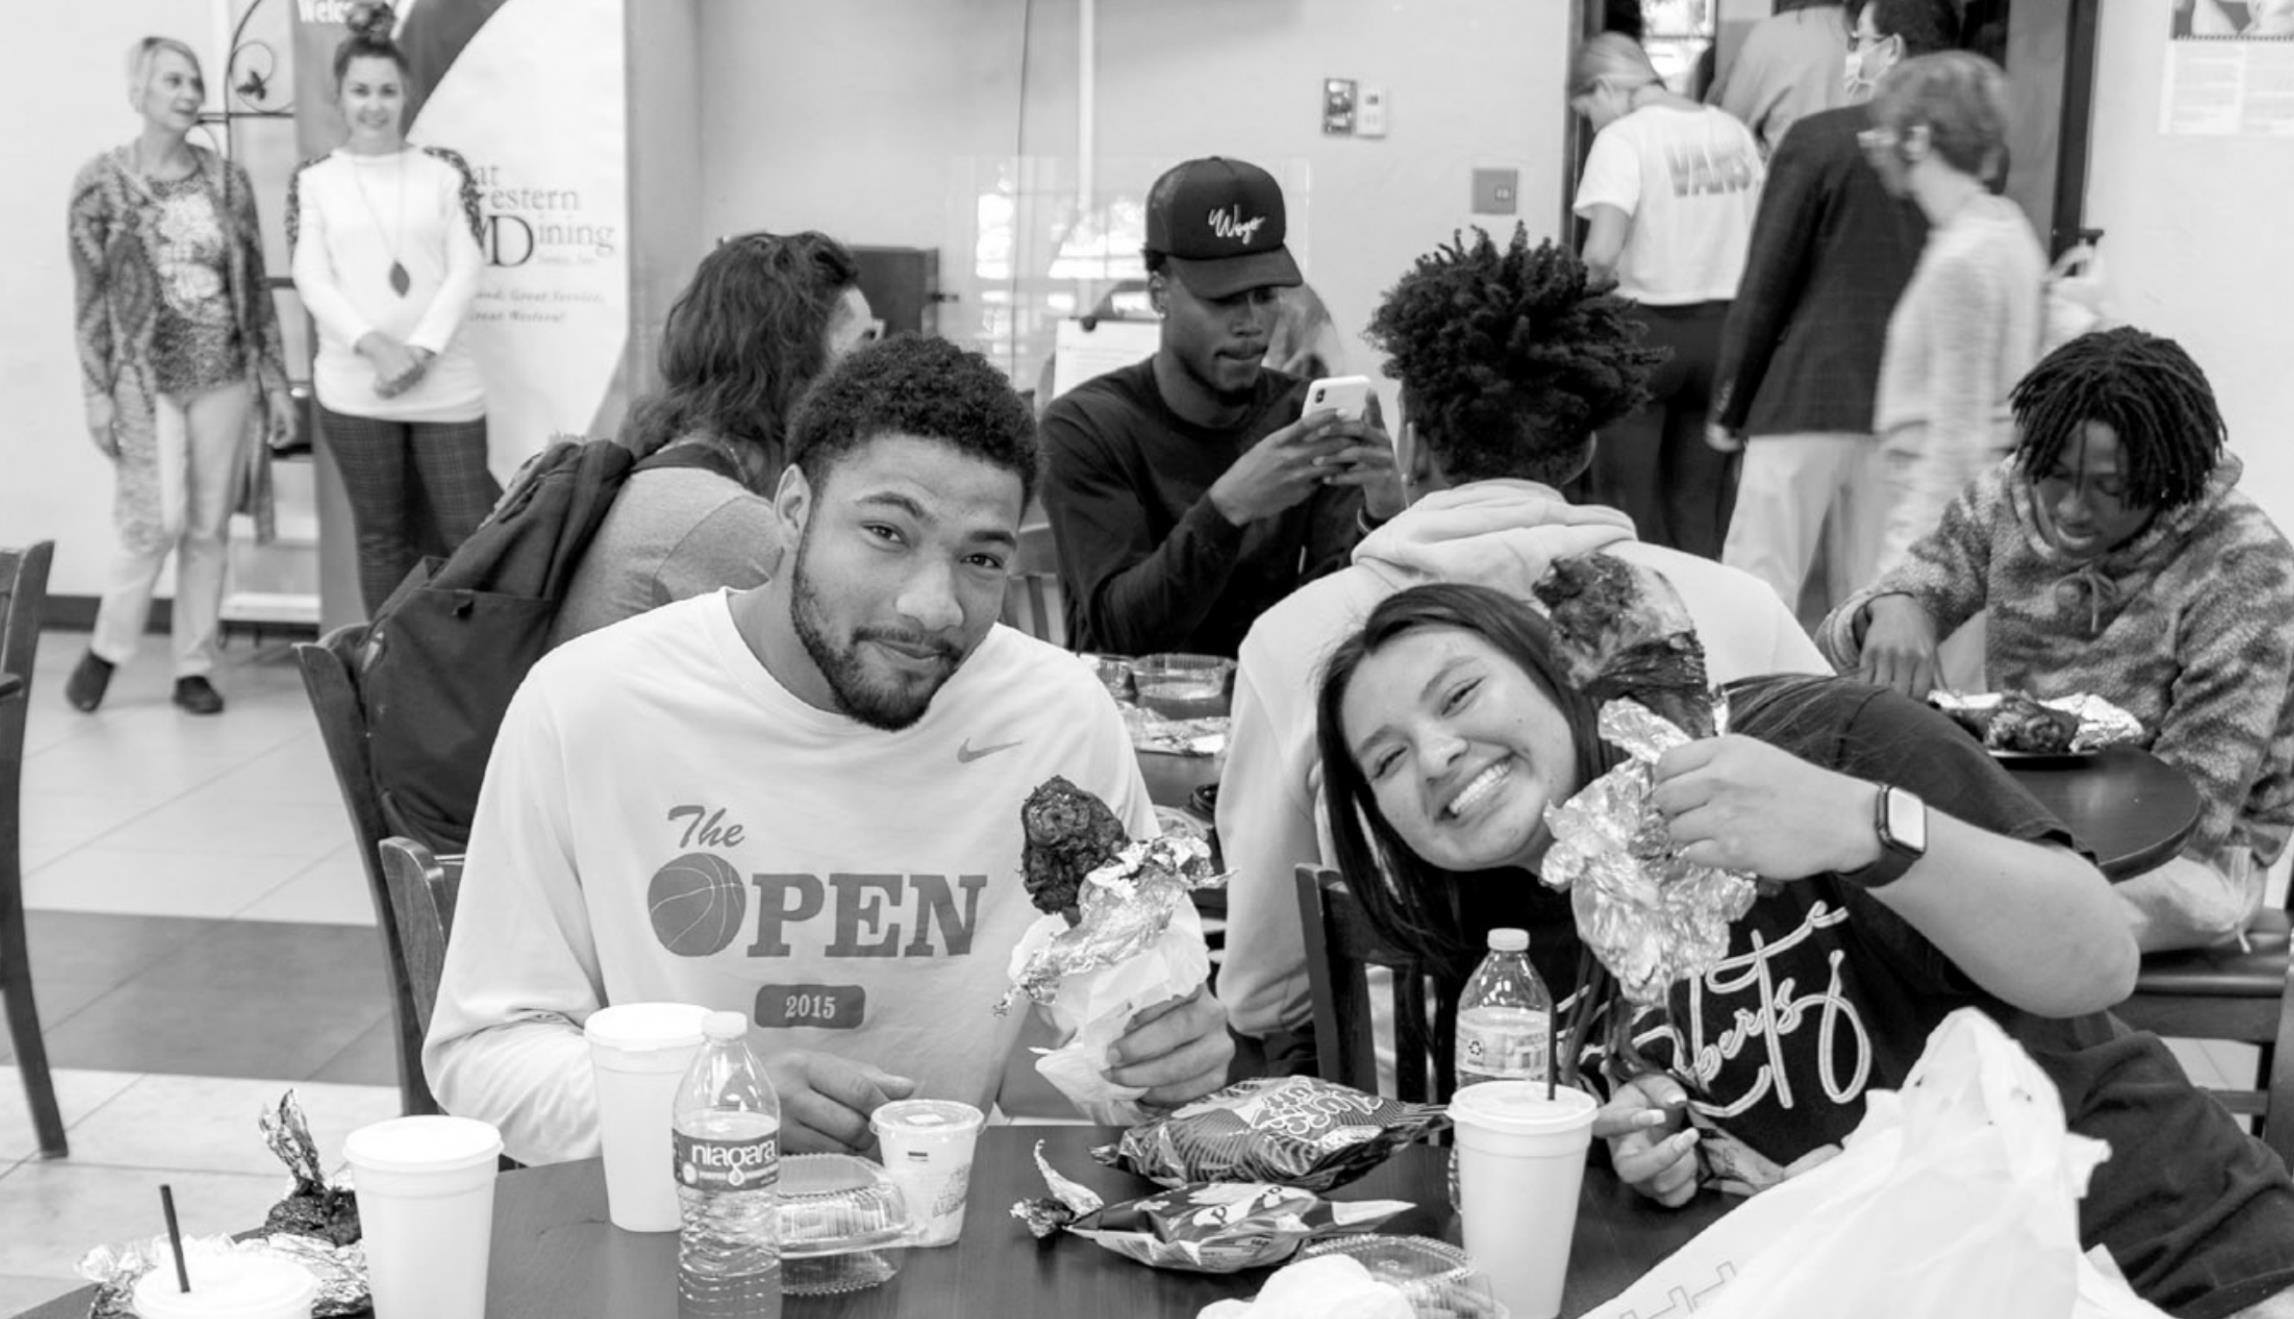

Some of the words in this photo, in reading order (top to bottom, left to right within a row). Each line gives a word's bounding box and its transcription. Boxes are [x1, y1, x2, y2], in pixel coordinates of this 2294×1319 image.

[667, 805, 745, 849] The
[785, 994, 836, 1019] 2015
[691, 1139, 777, 1187] niagara
